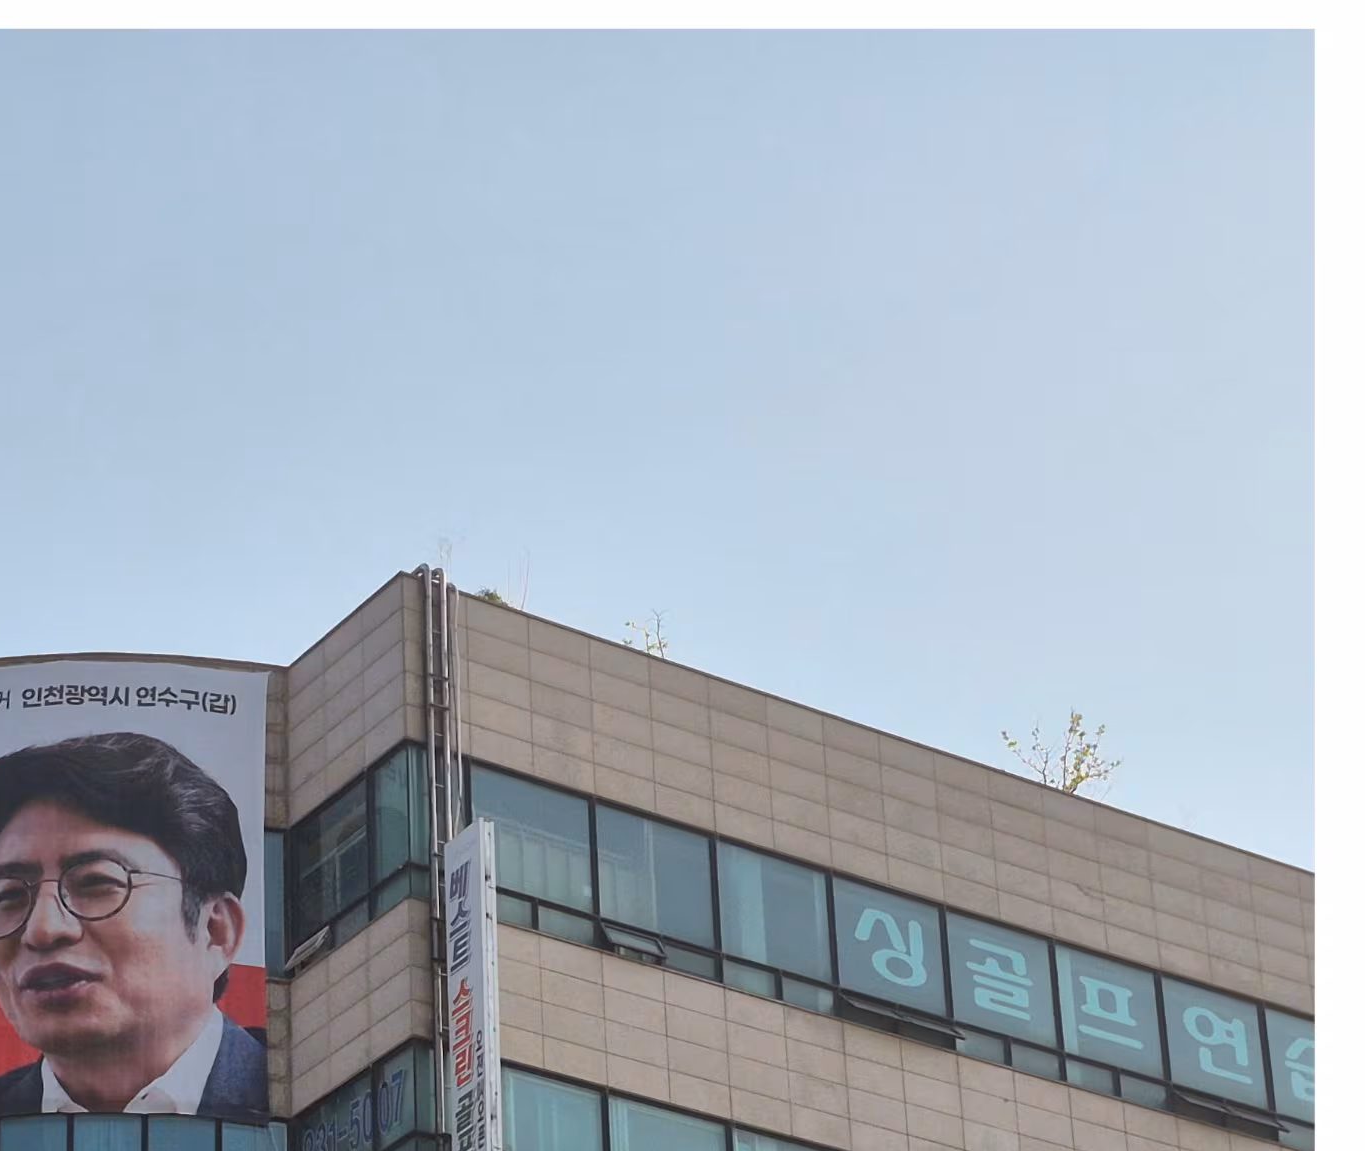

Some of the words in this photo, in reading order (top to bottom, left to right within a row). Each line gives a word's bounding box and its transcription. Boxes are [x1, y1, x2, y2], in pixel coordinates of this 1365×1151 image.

[21, 686, 130, 710] 인천광역시
[137, 687, 238, 716] 연수구(갑)
[449, 860, 473, 977] 베스트
[453, 977, 474, 1090] 스크린
